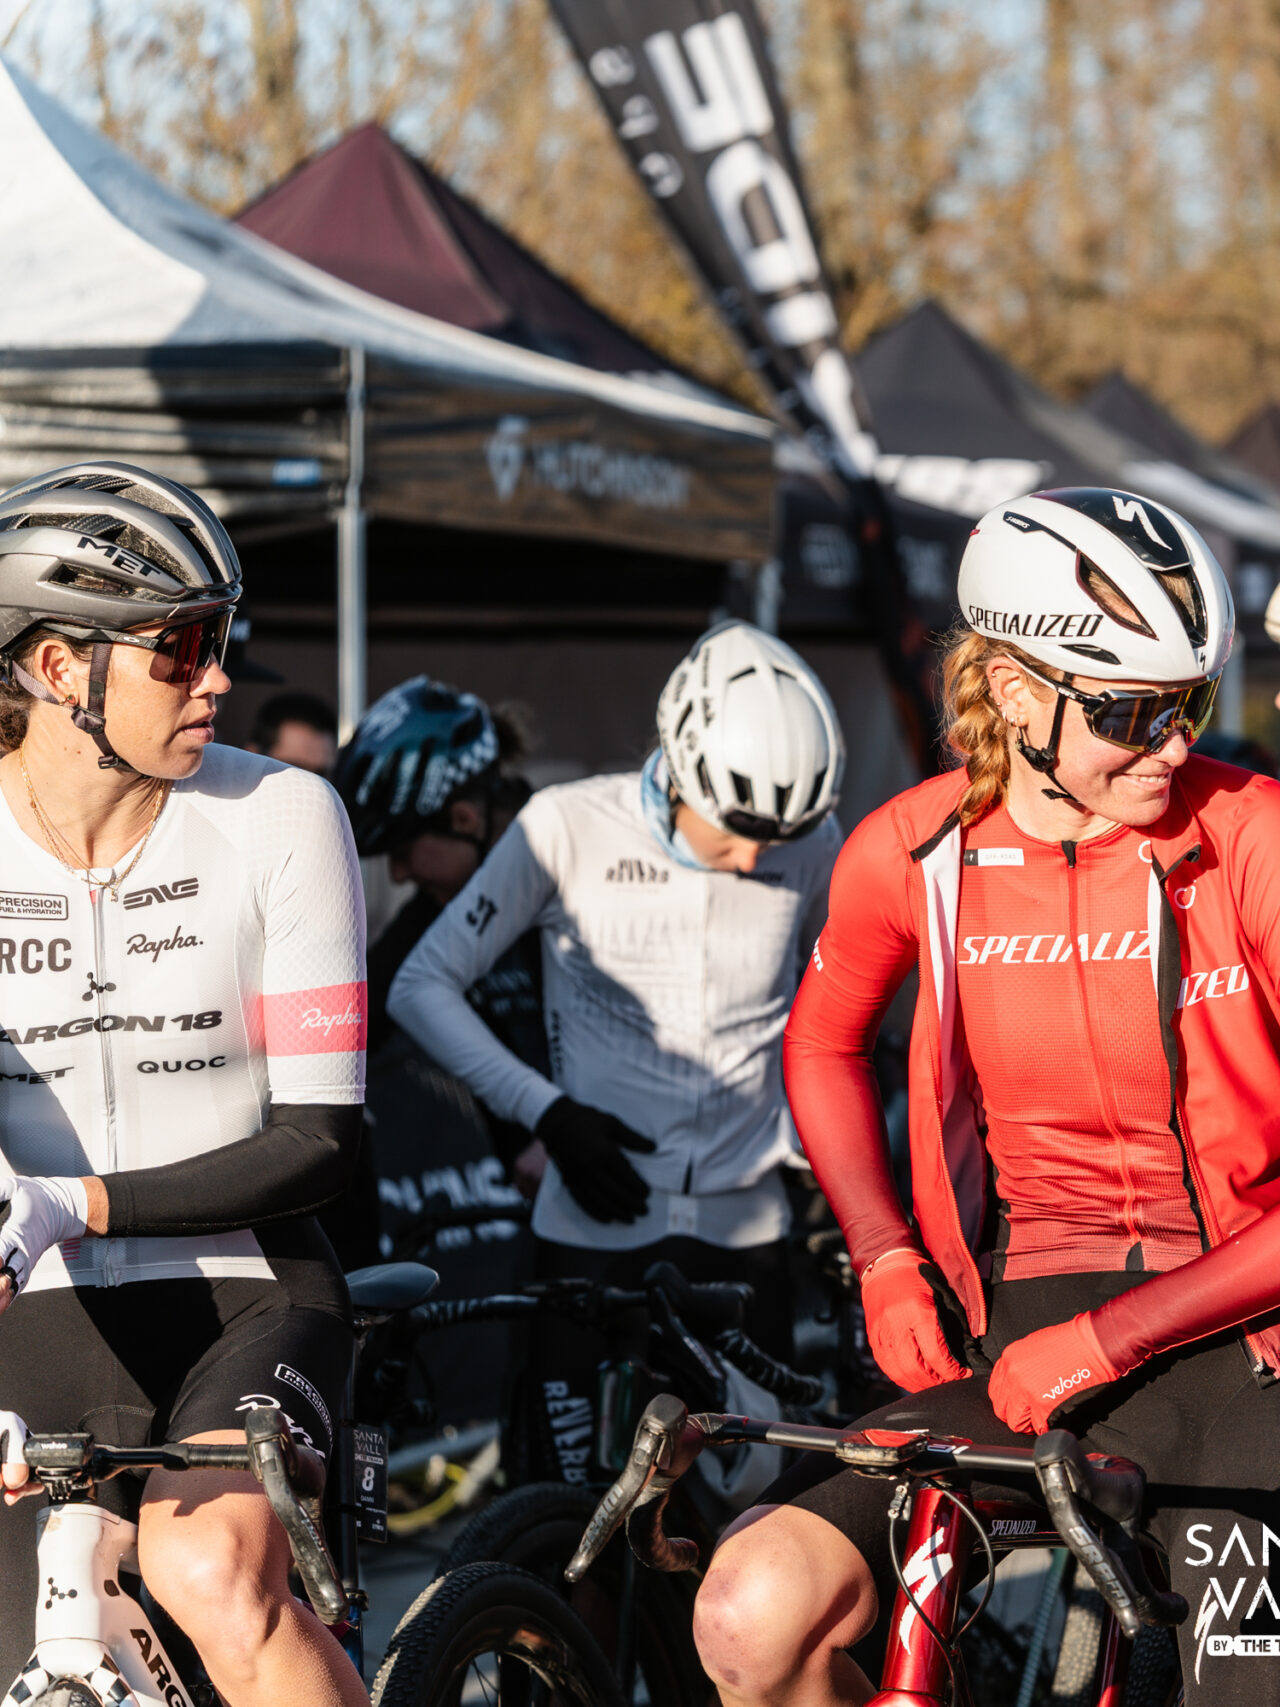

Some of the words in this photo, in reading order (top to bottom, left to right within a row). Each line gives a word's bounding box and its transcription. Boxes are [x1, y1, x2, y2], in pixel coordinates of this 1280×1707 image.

[77, 537, 162, 577] MET
[968, 605, 1104, 638] SPECIALIZED
[0, 896, 62, 909] PRECISION
[0, 938, 72, 974] RCC
[0, 1014, 166, 1045] ARGON
[171, 1010, 223, 1032] 18
[0, 1066, 75, 1085] MET
[137, 1055, 226, 1074] QUOC
[1042, 1367, 1092, 1401] velocio
[353, 1429, 384, 1446] SANTA
[355, 1440, 381, 1456] VALL
[362, 1466, 375, 1492] 8
[988, 1519, 1037, 1536] SPECIALIZED
[1068, 1526, 1131, 1608] SRAM
